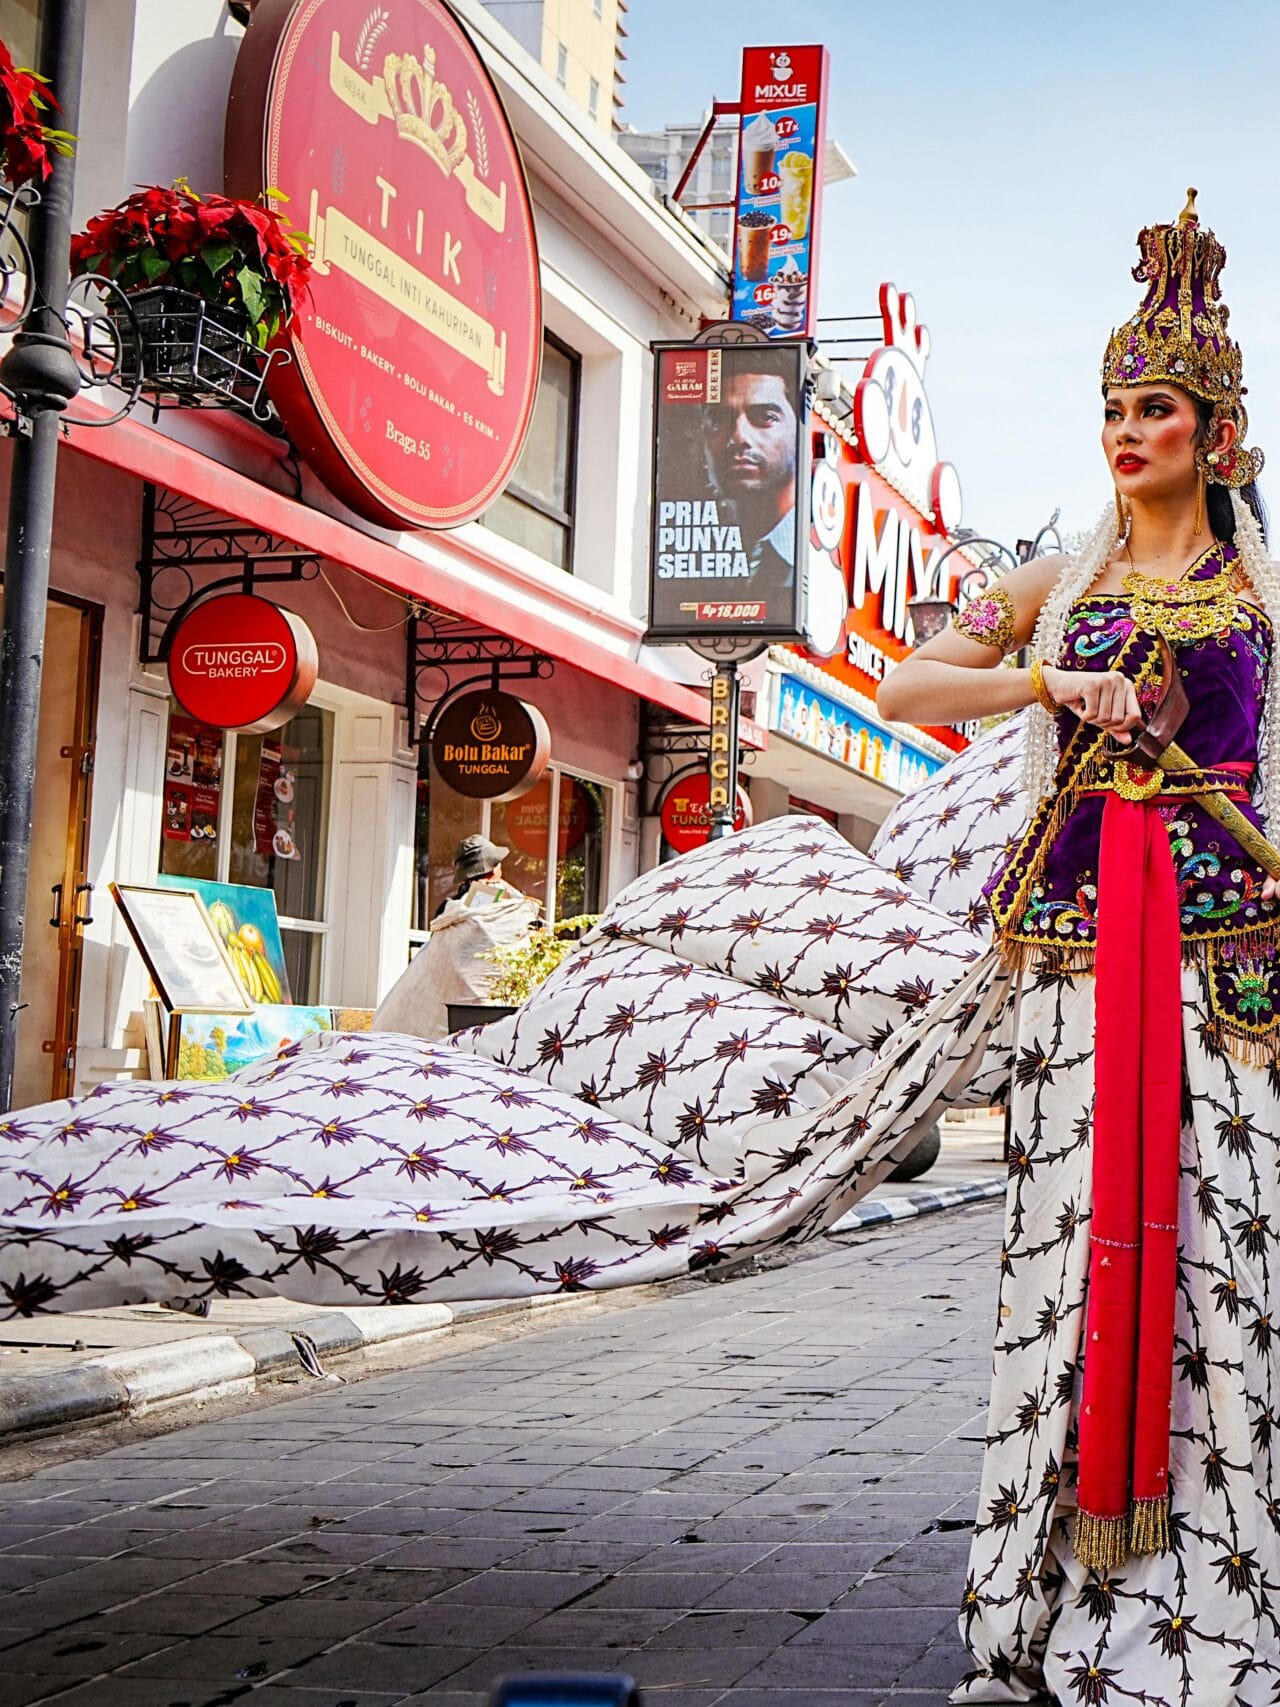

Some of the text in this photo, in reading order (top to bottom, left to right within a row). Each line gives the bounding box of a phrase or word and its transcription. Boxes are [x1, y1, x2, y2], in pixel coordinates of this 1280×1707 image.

[755, 84, 807, 98] MIXUE
[343, 234, 482, 349] TUNGGAL INTI KAHURIPAN
[316, 315, 494, 441] BISKUIT BAKERY BOLU BAKAR ES KRIM
[710, 351, 720, 400] KRETEK
[386, 419, 431, 461] Braga 55
[659, 500, 720, 526] PRIA
[658, 526, 743, 552] PUNYA
[657, 552, 750, 579] SELERA
[194, 650, 274, 666] TUNGGAL
[847, 631, 884, 681] SINCE
[208, 667, 258, 678] BAKERY
[444, 744, 525, 761] Bolu Bakar
[710, 679, 730, 806] BRAGA
[459, 764, 510, 774] TUNGGAL
